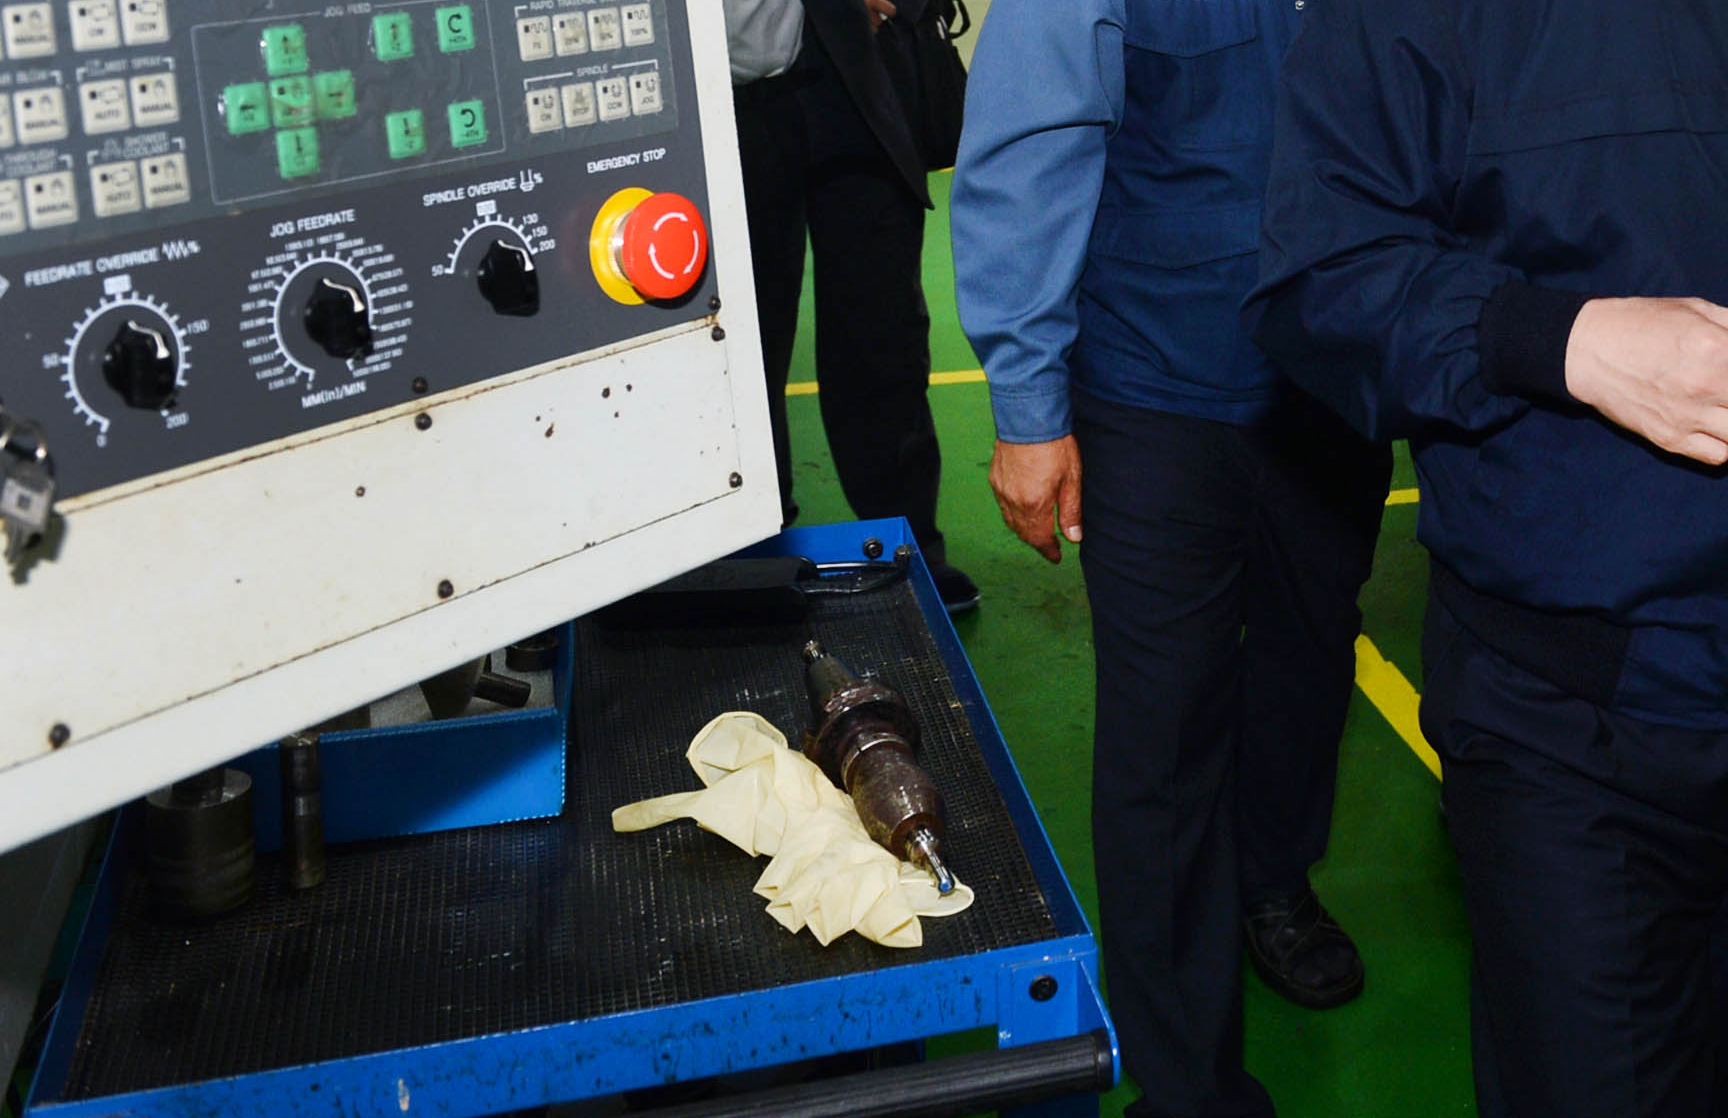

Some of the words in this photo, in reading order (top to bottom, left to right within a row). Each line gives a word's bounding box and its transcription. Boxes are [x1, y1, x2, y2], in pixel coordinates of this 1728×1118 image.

[323, 5, 345, 18] JOG
[347, 2, 372, 14] FEED
[530, 0, 554, 10] RAPID
[577, 63, 609, 77] SPINDLE
[587, 152, 641, 174] EMERGENCY
[643, 147, 666, 163] STOP
[422, 187, 465, 207] SPINDLE
[467, 176, 518, 199] OVERRIDE
[270, 221, 295, 239] JOG
[297, 208, 356, 233] FEEDRATE
[523, 213, 539, 226] 130
[532, 225, 548, 238] 150
[539, 239, 556, 252] 200
[24, 259, 94, 287] FEEDRATE
[96, 246, 160, 273] OVERRIDE
[432, 264, 444, 277] 50
[187, 319, 209, 334] 150
[42, 352, 60, 369] 50
[166, 412, 189, 429] 200
